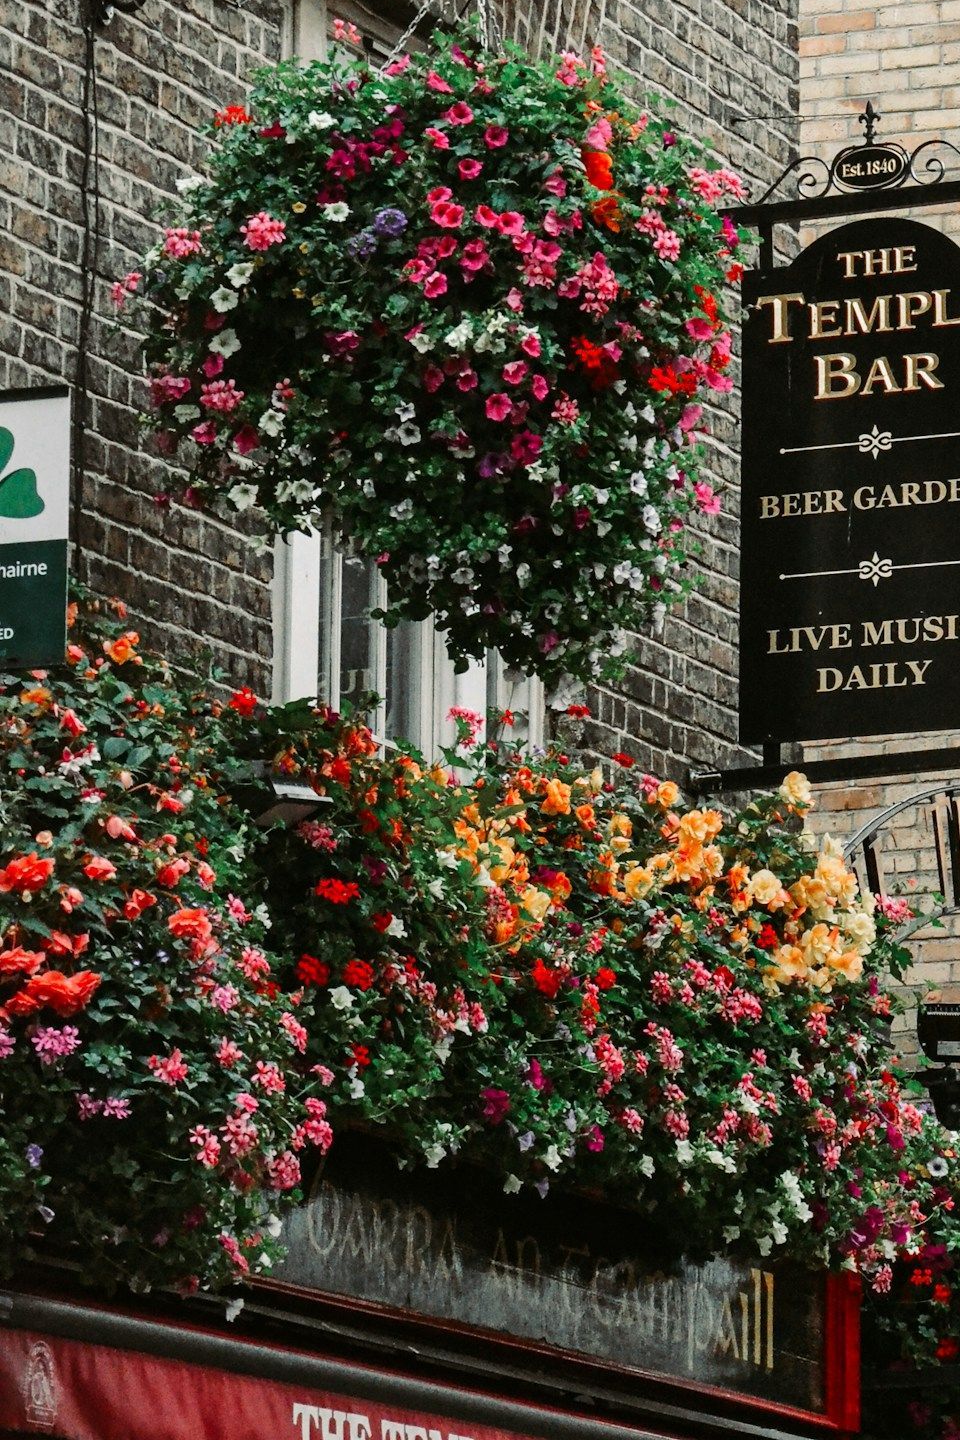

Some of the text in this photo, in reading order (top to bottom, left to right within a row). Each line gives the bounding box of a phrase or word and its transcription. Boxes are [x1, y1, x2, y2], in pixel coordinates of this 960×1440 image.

[837, 245, 918, 279] THE
[814, 352, 945, 400] BAR
[759, 489, 848, 520] BEER
[766, 623, 853, 655] LIVE
[816, 660, 933, 693] DAILY
